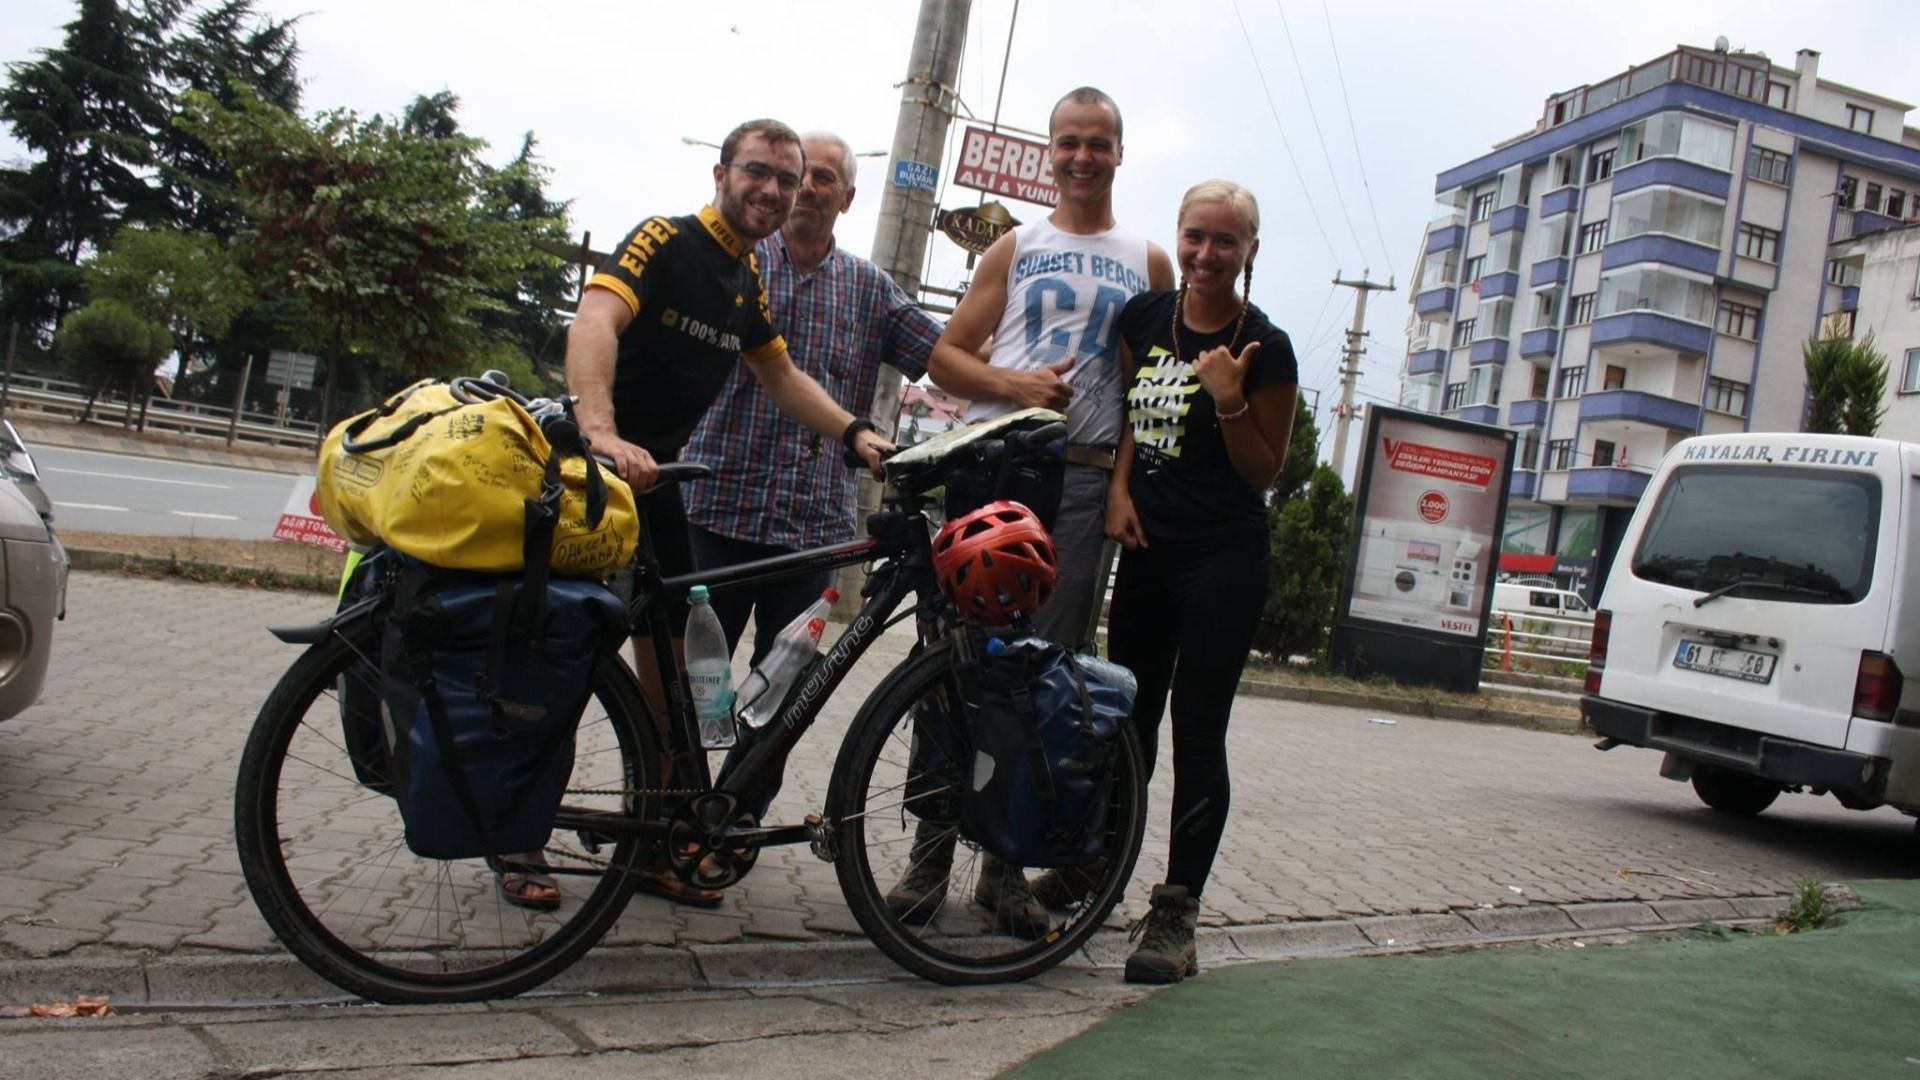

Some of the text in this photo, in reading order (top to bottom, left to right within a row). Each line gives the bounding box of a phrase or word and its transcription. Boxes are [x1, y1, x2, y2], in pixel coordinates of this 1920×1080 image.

[964, 133, 1057, 185] BERBE
[959, 171, 995, 189] ALİ
[1001, 181, 1009, 193] &
[1016, 182, 1061, 203] YUNU
[618, 216, 679, 278] EIFEL
[710, 221, 736, 247] EIFEL
[1016, 251, 1148, 294] SUNSET BEACH
[680, 316, 718, 345] 100%
[1684, 445, 1878, 467] KAYALAR FIRINI
[1441, 619, 1474, 633] VESTEL
[1686, 645, 1701, 664] 61
